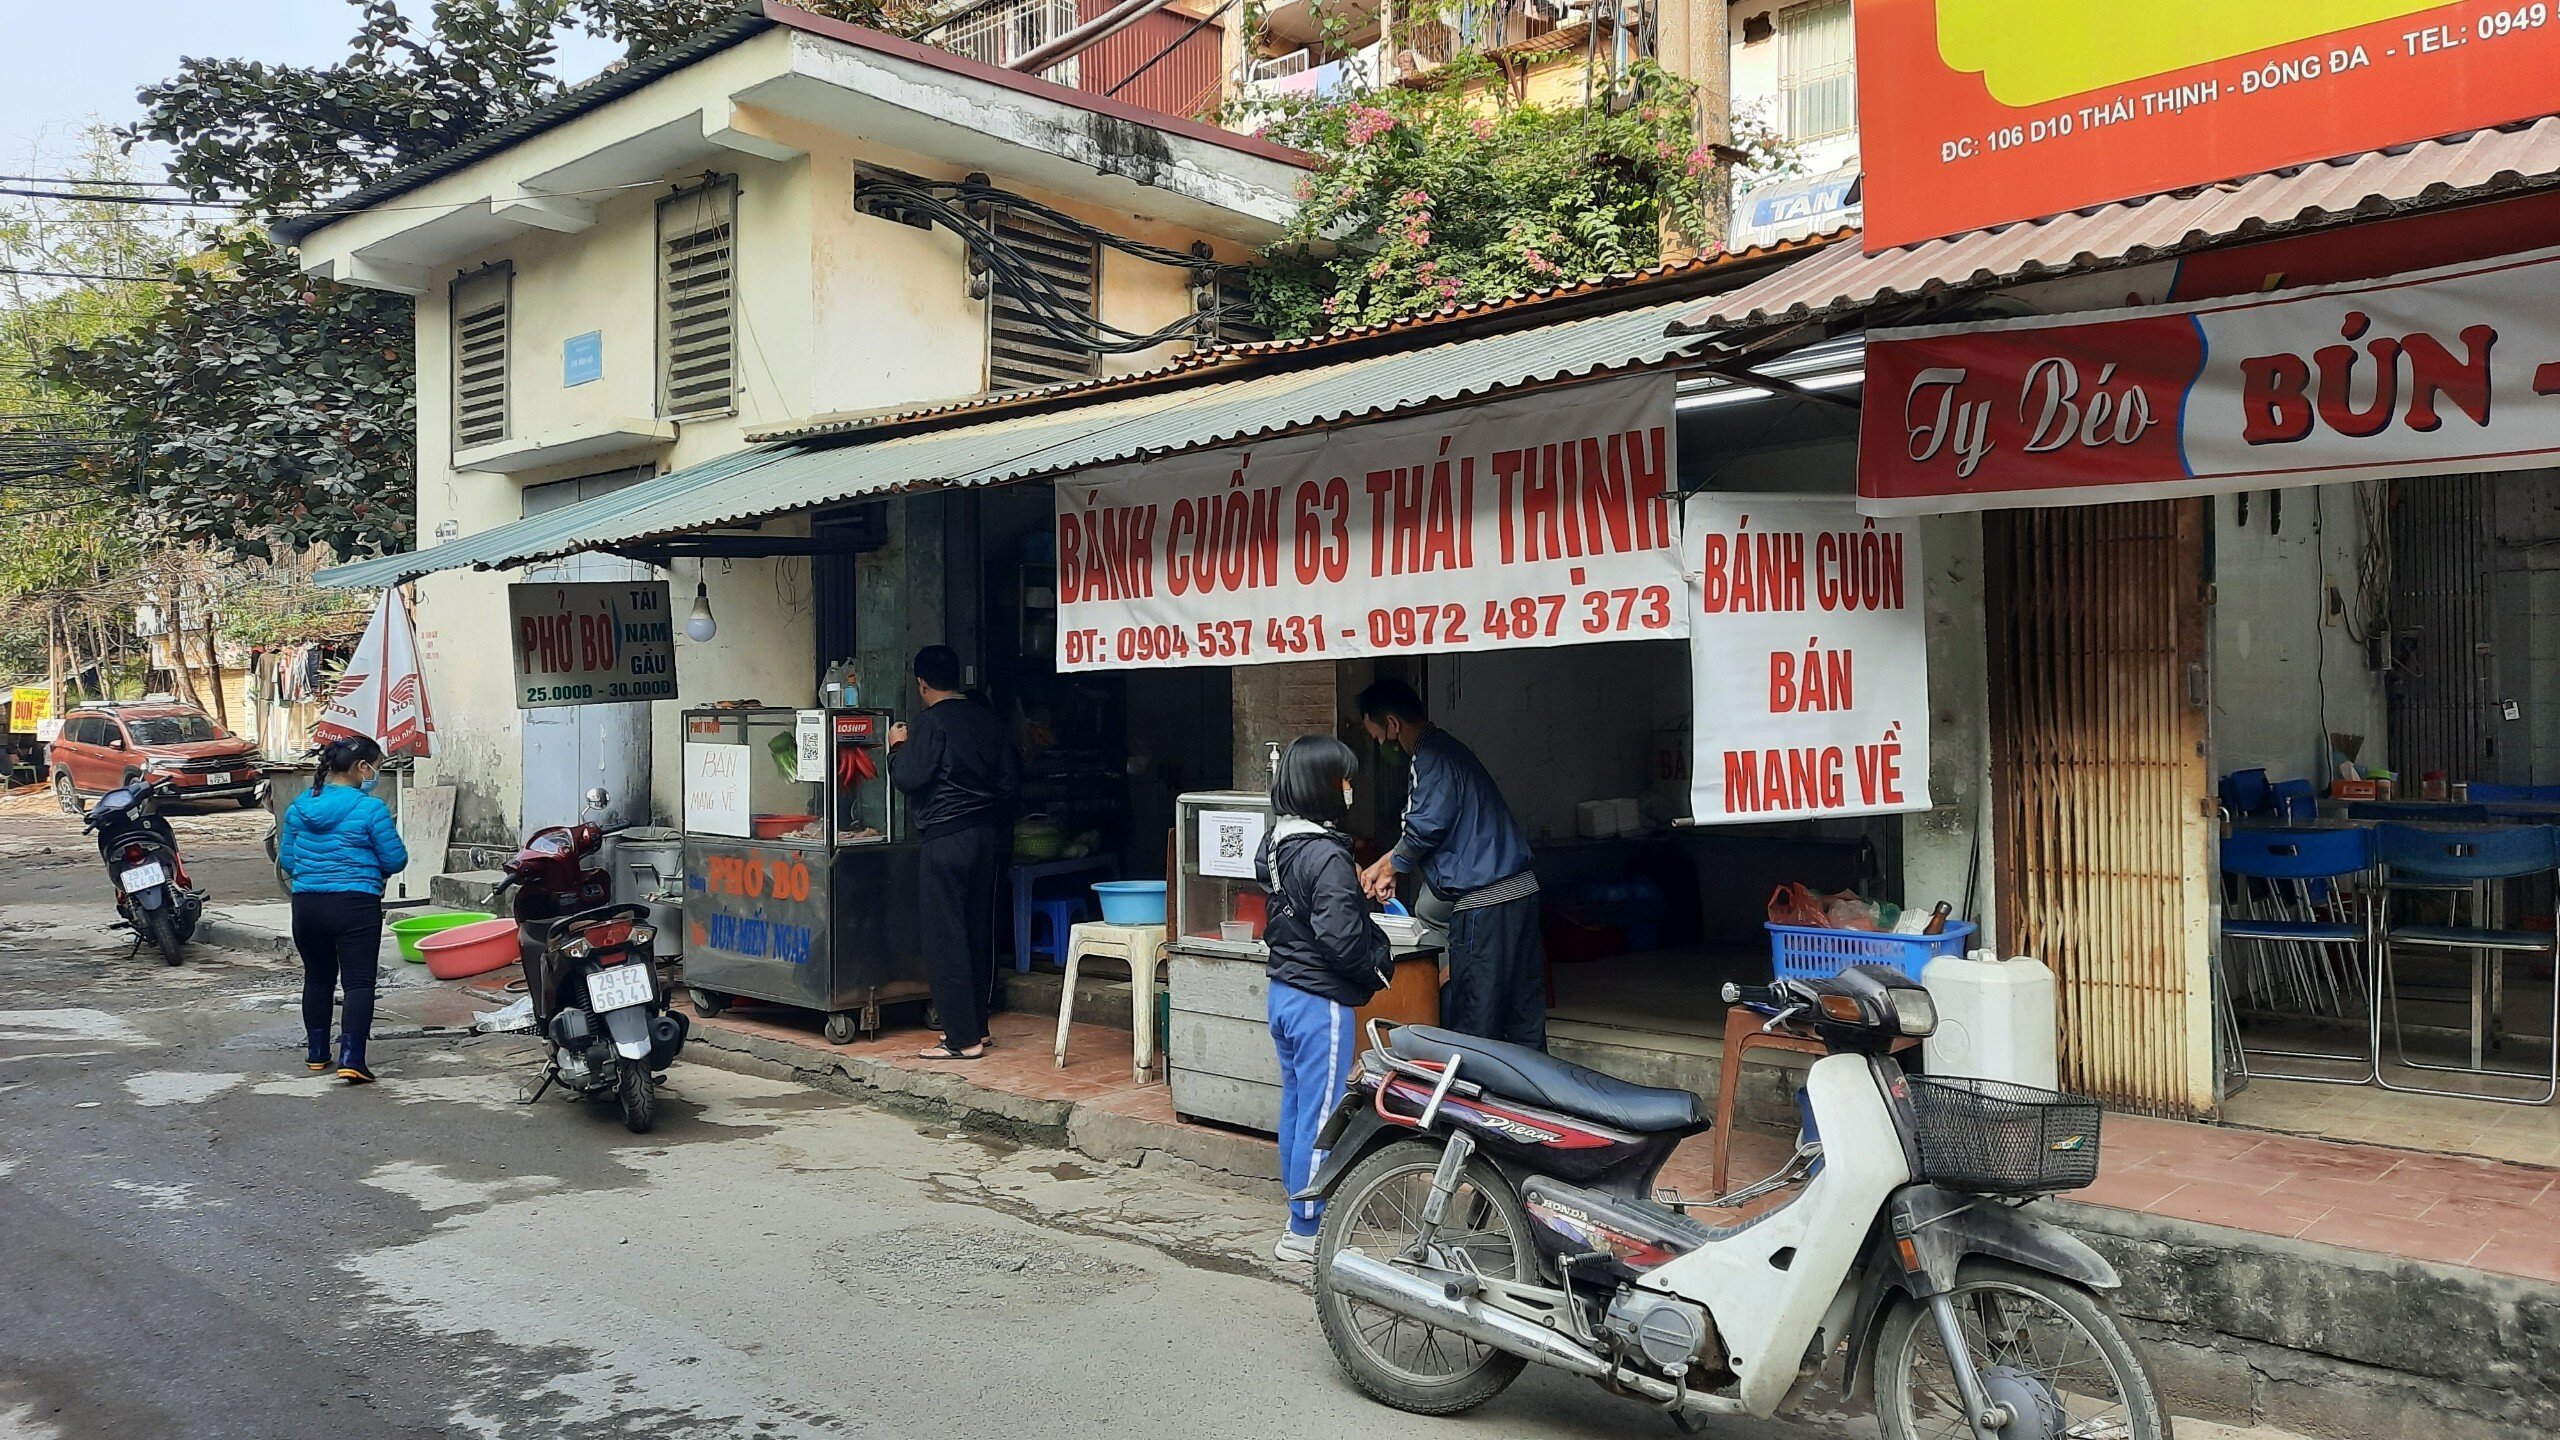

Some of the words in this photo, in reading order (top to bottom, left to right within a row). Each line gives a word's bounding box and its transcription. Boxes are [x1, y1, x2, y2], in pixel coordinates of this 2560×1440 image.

[1941, 136, 1980, 164] ĐC:
[1987, 125, 2024, 153] 106
[2030, 114, 2073, 143] D10
[2080, 96, 2136, 132] THÁI
[2142, 80, 2219, 117] THỊNH
[2241, 55, 2322, 97] ĐỐNG
[2328, 43, 2370, 74] ĐA
[2402, 25, 2467, 56] TEL:
[2477, 2, 2547, 40] 0949
[2018, 355, 2159, 455] Béo
[2241, 311, 2498, 446] BÚN
[1059, 490, 1157, 604] BÁNH
[1166, 451, 1280, 595] CUỐN
[1294, 475, 1350, 586] 63
[1366, 435, 1475, 578] THÁI
[1492, 426, 1672, 586] THỊNH
[1703, 515, 1805, 614] BÁNH
[520, 589, 573, 675] PHỞ
[579, 600, 615, 672] BÒ
[629, 587, 658, 611] TÁI
[1065, 628, 1106, 664] ĐT:
[1116, 624, 1189, 662] 0904
[1198, 619, 1252, 658] 537
[1266, 614, 1325, 655] 431
[1368, 602, 1468, 649] 0972
[1483, 594, 1566, 640] 487
[1582, 585, 1671, 634] 373
[624, 623, 668, 648] NẠM
[1770, 637, 1852, 713] BÁN
[701, 746, 737, 778] BÁN
[1723, 746, 1846, 814] MANG
[1855, 721, 1905, 806] VỀ
[690, 790, 715, 811] MANG
[721, 783, 738, 812] VỀ
[708, 847, 764, 898] PHỞ
[771, 850, 811, 903] BÒ
[596, 984, 648, 1009] 563.41
[597, 969, 640, 992] 29-E2
[1481, 1111, 1566, 1144] Dream
[1542, 1199, 1590, 1222] HONDA
